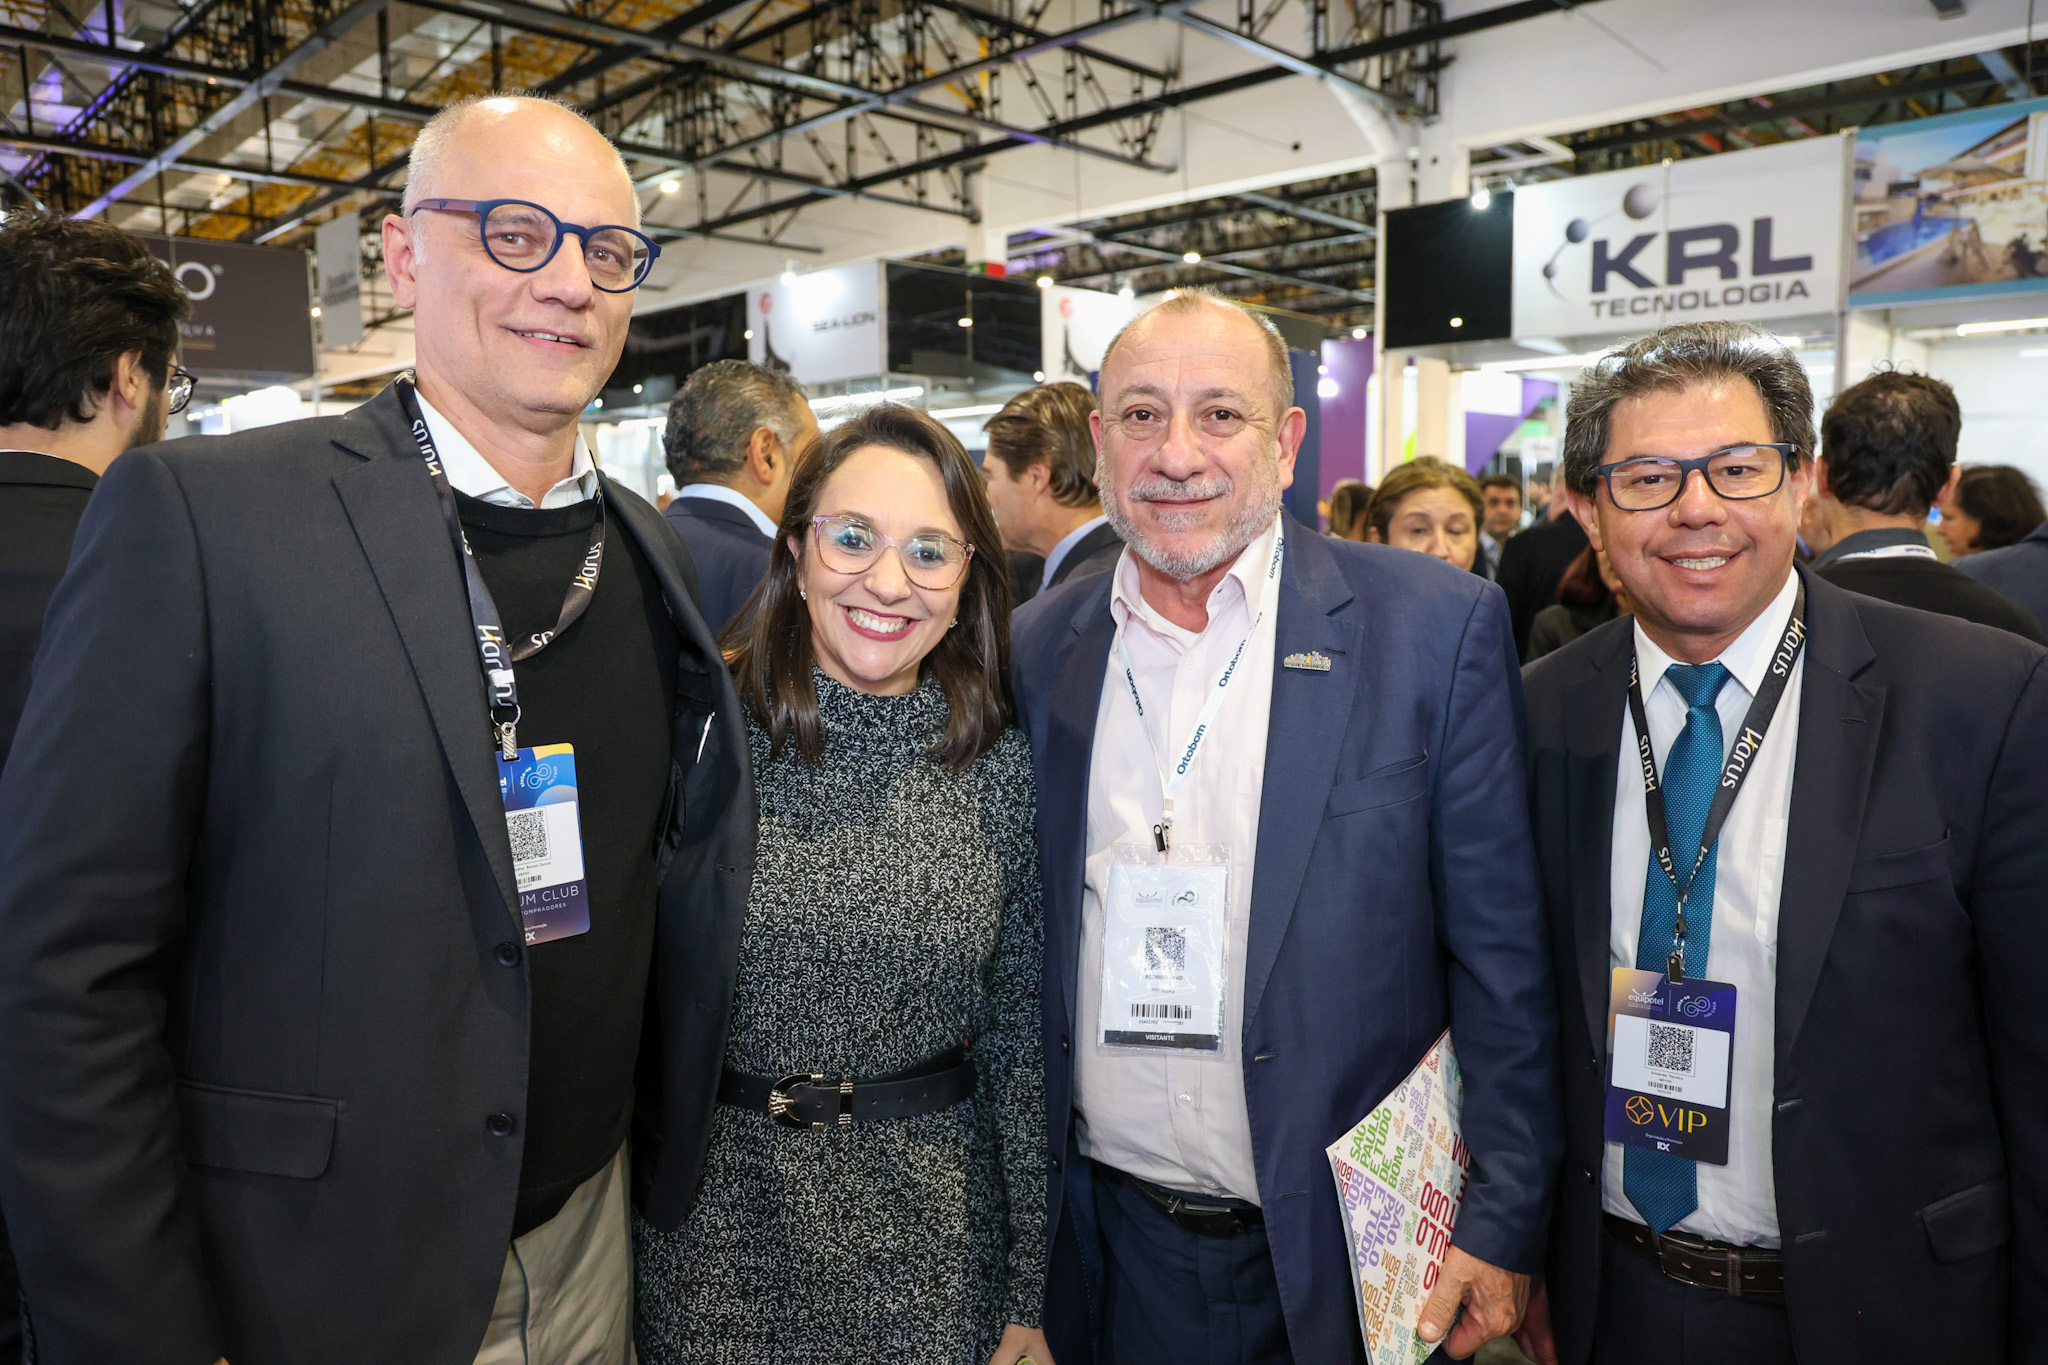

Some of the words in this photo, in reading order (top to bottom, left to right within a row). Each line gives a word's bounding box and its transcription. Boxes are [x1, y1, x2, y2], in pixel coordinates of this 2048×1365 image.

[1591, 217, 1813, 294] KRL
[1591, 279, 1809, 318] TECNOLOGIA
[1218, 639, 1246, 687] Ortobom
[1772, 617, 1806, 678] Harus
[1126, 667, 1144, 716] Ortobom
[1176, 723, 1206, 775] Ortobom
[1722, 726, 1763, 789] Harus
[542, 885, 579, 902] CLUB
[1628, 994, 1664, 1006] equipotel
[1145, 1034, 1175, 1042] VISITANTE
[1360, 1108, 1380, 1169] PAULO
[1373, 1107, 1392, 1155] TUDO
[1657, 1103, 1708, 1133] VIP
[1379, 1154, 1392, 1183] DE
[1388, 1145, 1405, 1189] BOM.
[1359, 1176, 1376, 1211] DE
[1420, 1181, 1456, 1232] TUDO
[1357, 1209, 1381, 1268] TUDO
[1369, 1193, 1396, 1267] PAULO
[1387, 1200, 1405, 1246] SÃO
[1416, 1216, 1450, 1263] AULO
[1362, 1280, 1382, 1309] TUDO
[1382, 1273, 1396, 1295] DE
